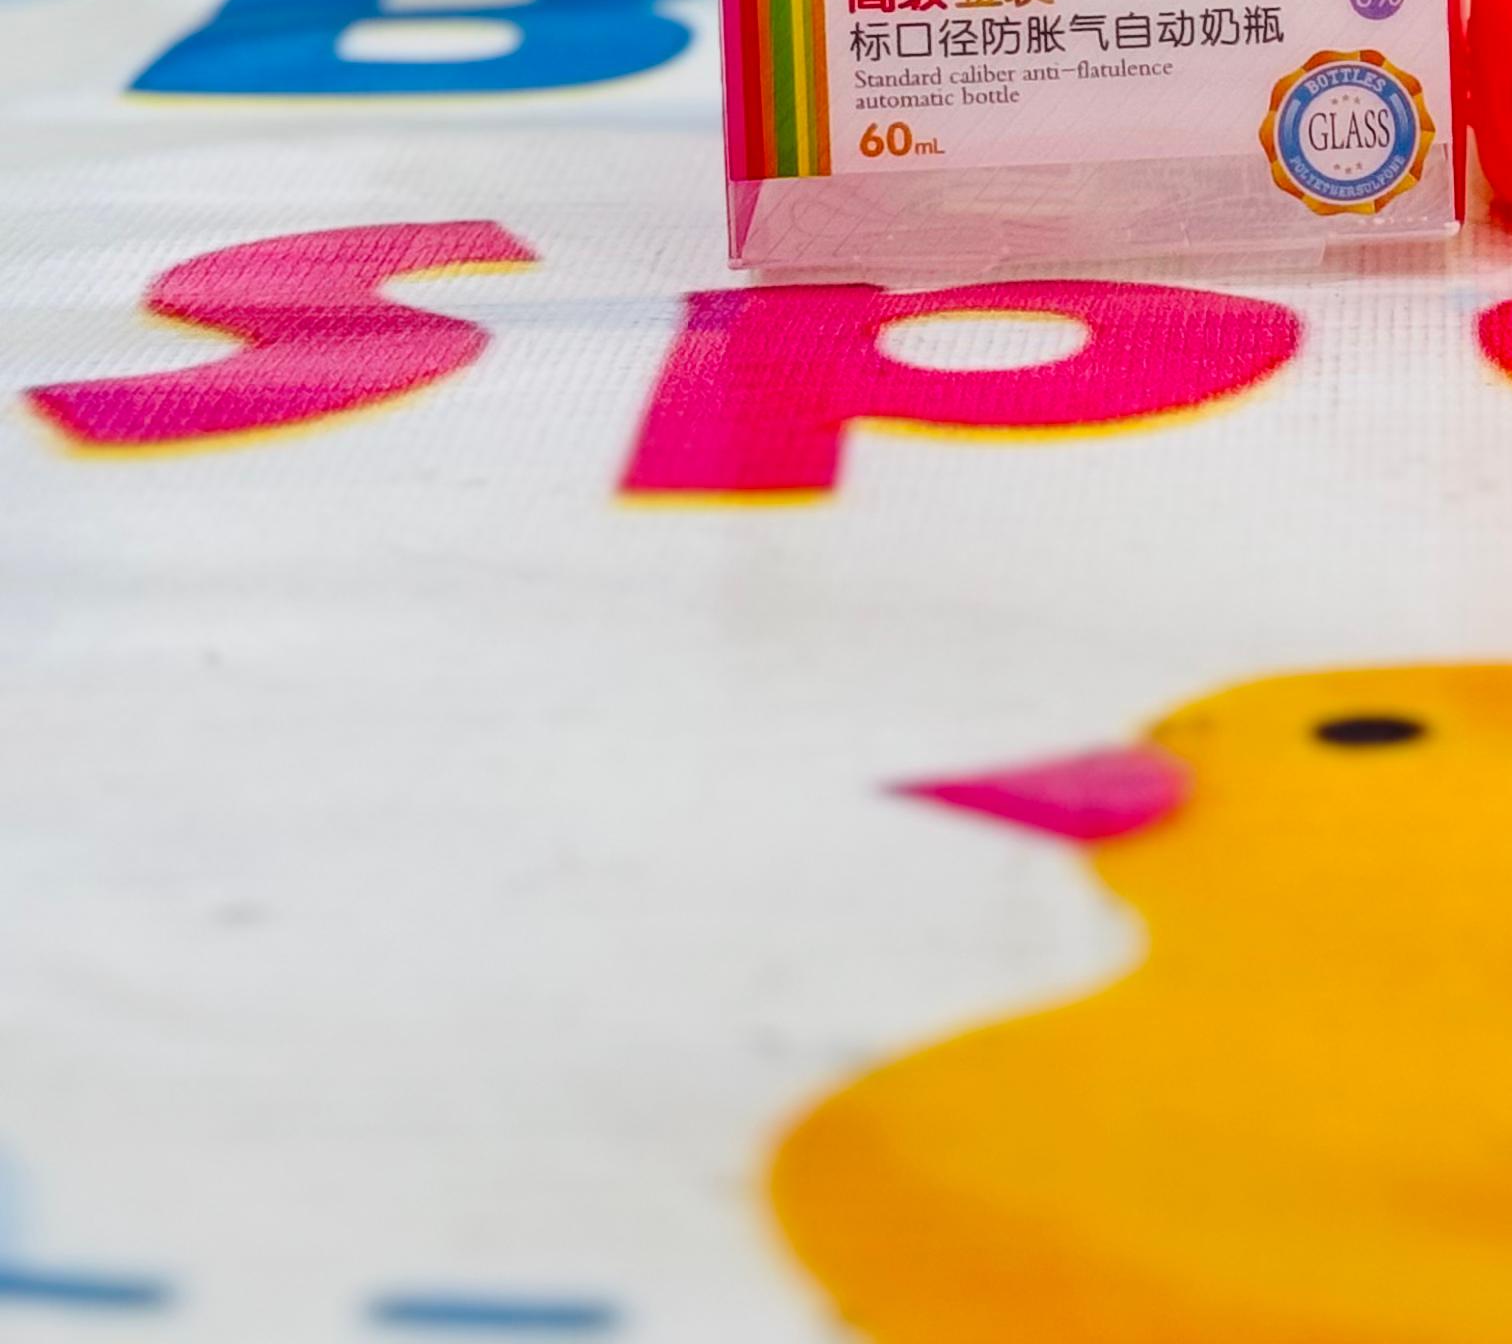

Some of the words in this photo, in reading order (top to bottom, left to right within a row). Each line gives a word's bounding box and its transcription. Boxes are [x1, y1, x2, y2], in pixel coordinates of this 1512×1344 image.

[849, 4, 1285, 62] 标口径防胀气自动奶瓶
[854, 67, 942, 88] Standard
[949, 65, 1014, 85] caliber
[1022, 58, 1174, 82] anti-flatulence
[1304, 67, 1387, 95] BOTTLES
[855, 89, 955, 110] automatic
[961, 86, 1020, 106] bottle
[1308, 108, 1391, 151] GLASS
